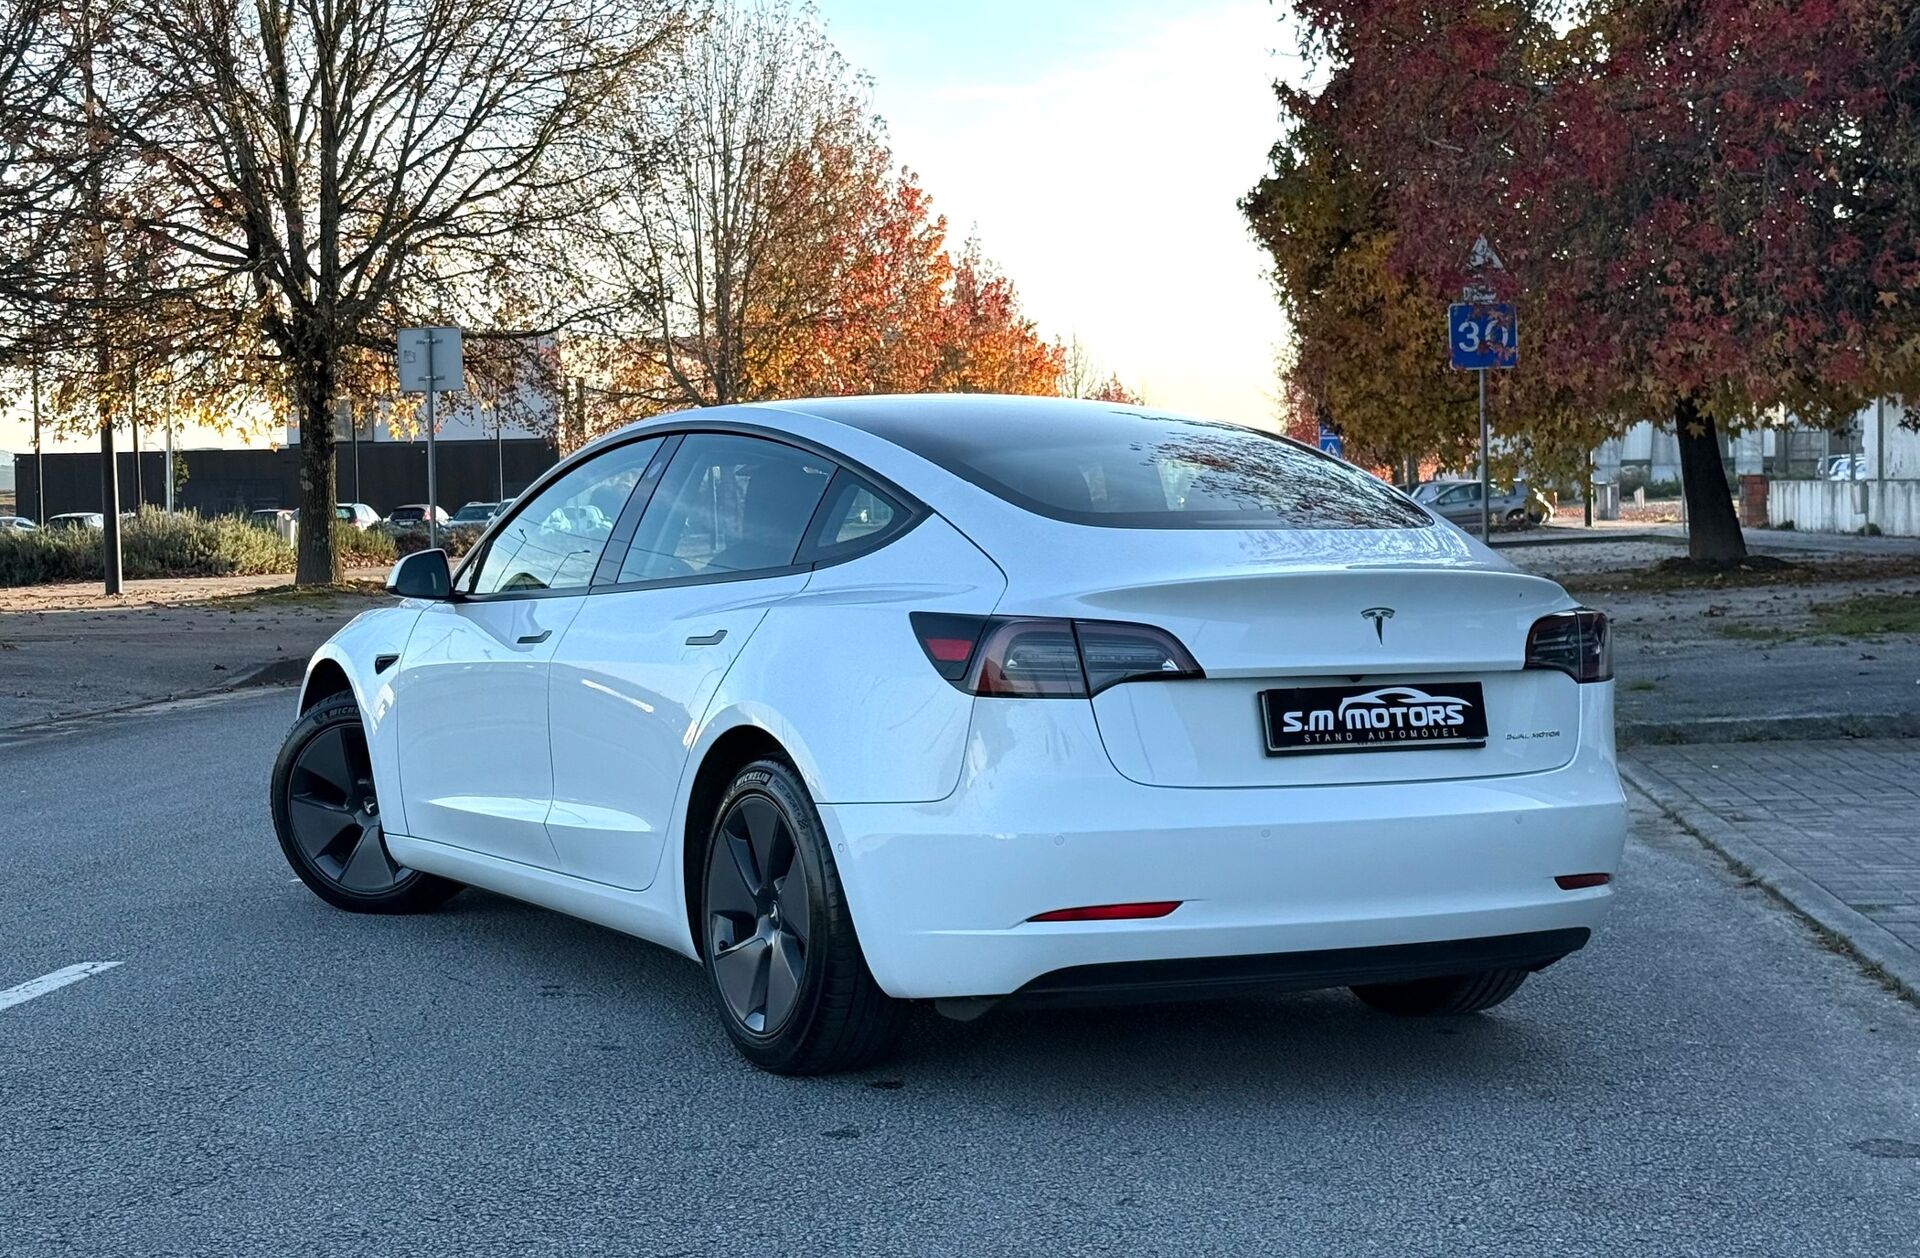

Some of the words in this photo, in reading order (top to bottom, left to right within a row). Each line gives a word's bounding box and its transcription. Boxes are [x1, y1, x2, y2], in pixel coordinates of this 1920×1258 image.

[1458, 320, 1509, 352] 30
[1345, 704, 1464, 729] MOTORS
[1304, 733, 1353, 743] STAND
[1368, 728, 1459, 740] AUTOMÓVEL
[1532, 730, 1560, 738] MOTOR
[735, 770, 771, 788] MICHELIN
